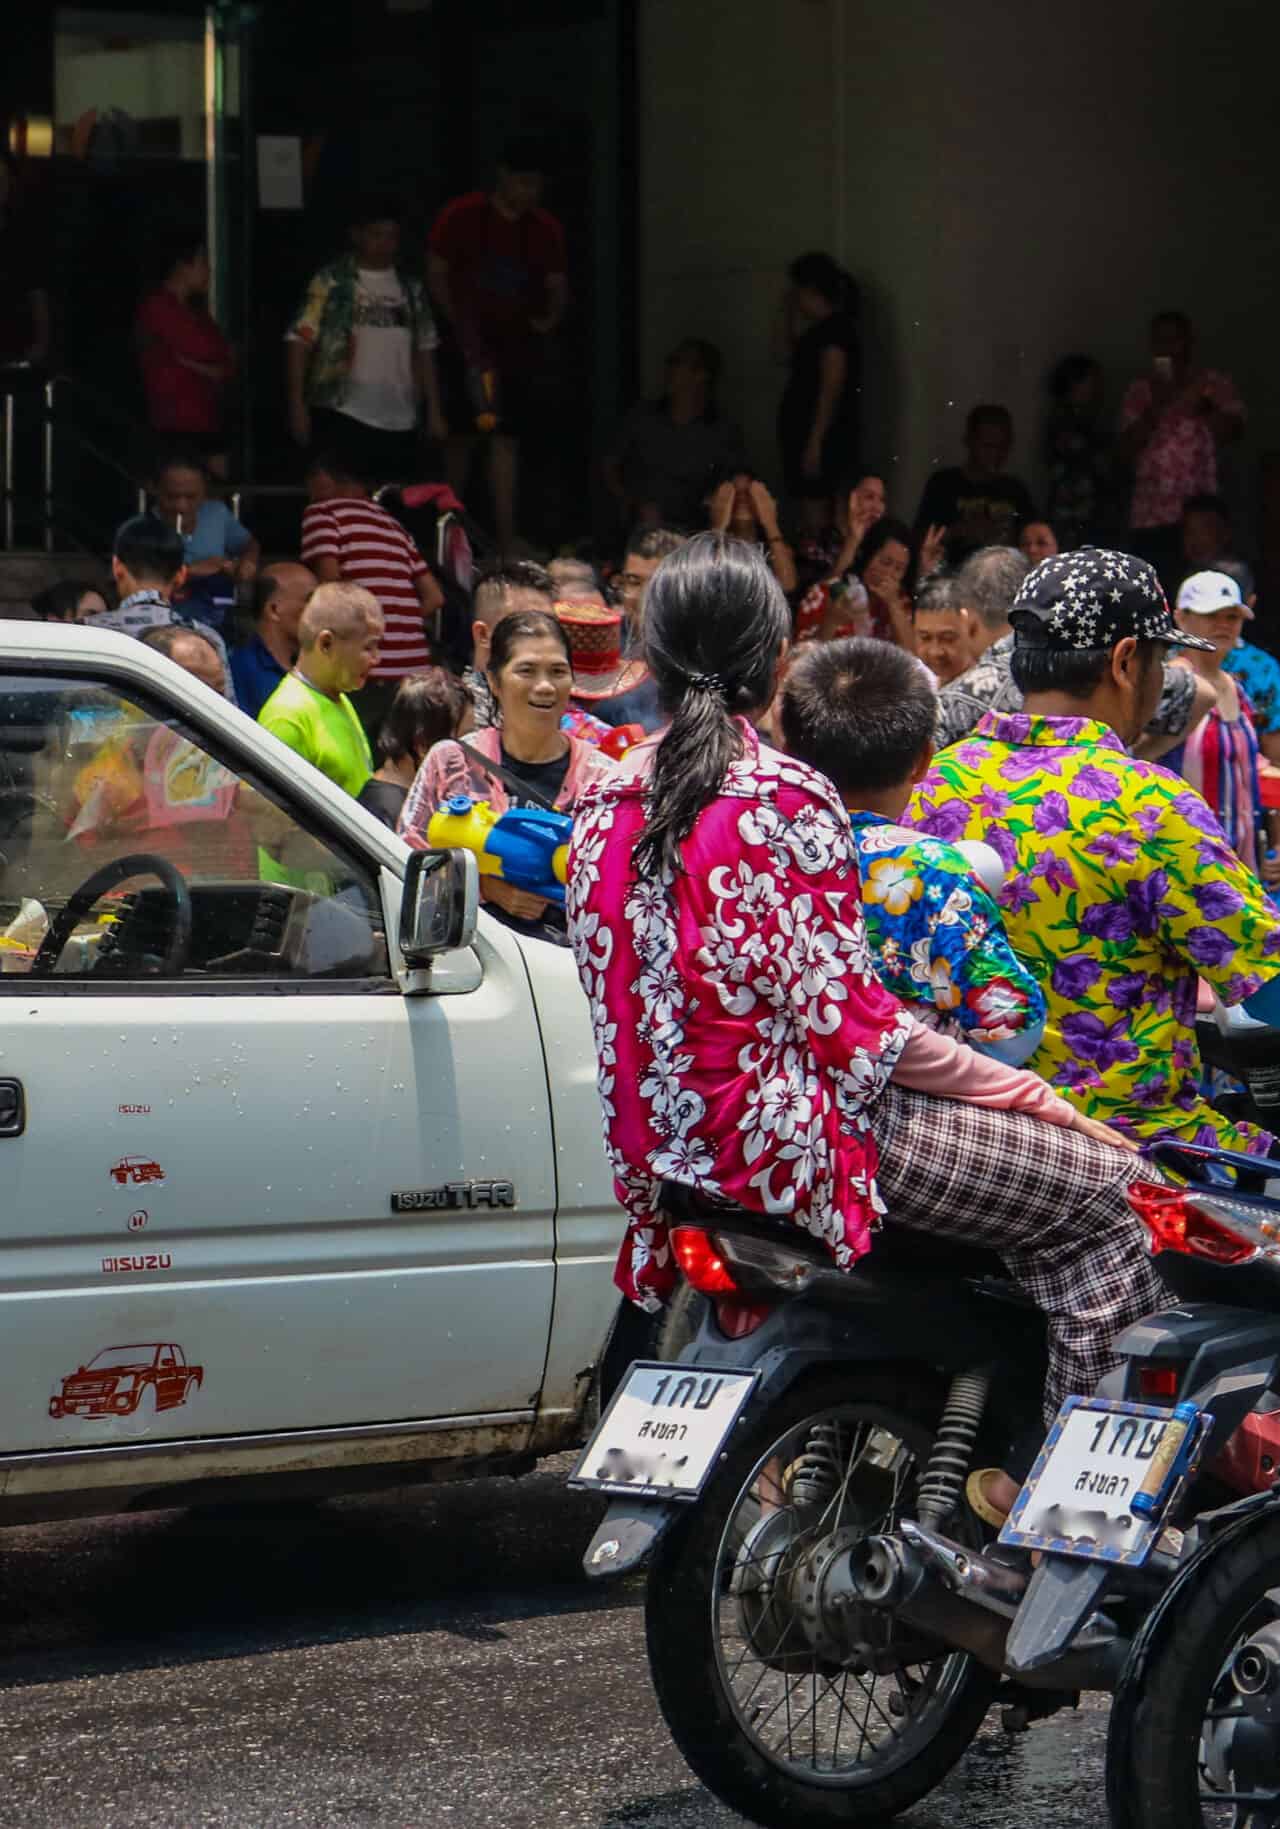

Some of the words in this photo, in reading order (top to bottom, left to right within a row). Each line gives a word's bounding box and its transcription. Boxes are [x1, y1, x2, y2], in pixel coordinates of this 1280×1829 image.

[114, 1253, 172, 1273] ISUZU
[638, 1420, 689, 1441] สงขลา
[1074, 1470, 1130, 1497] สงขลา
